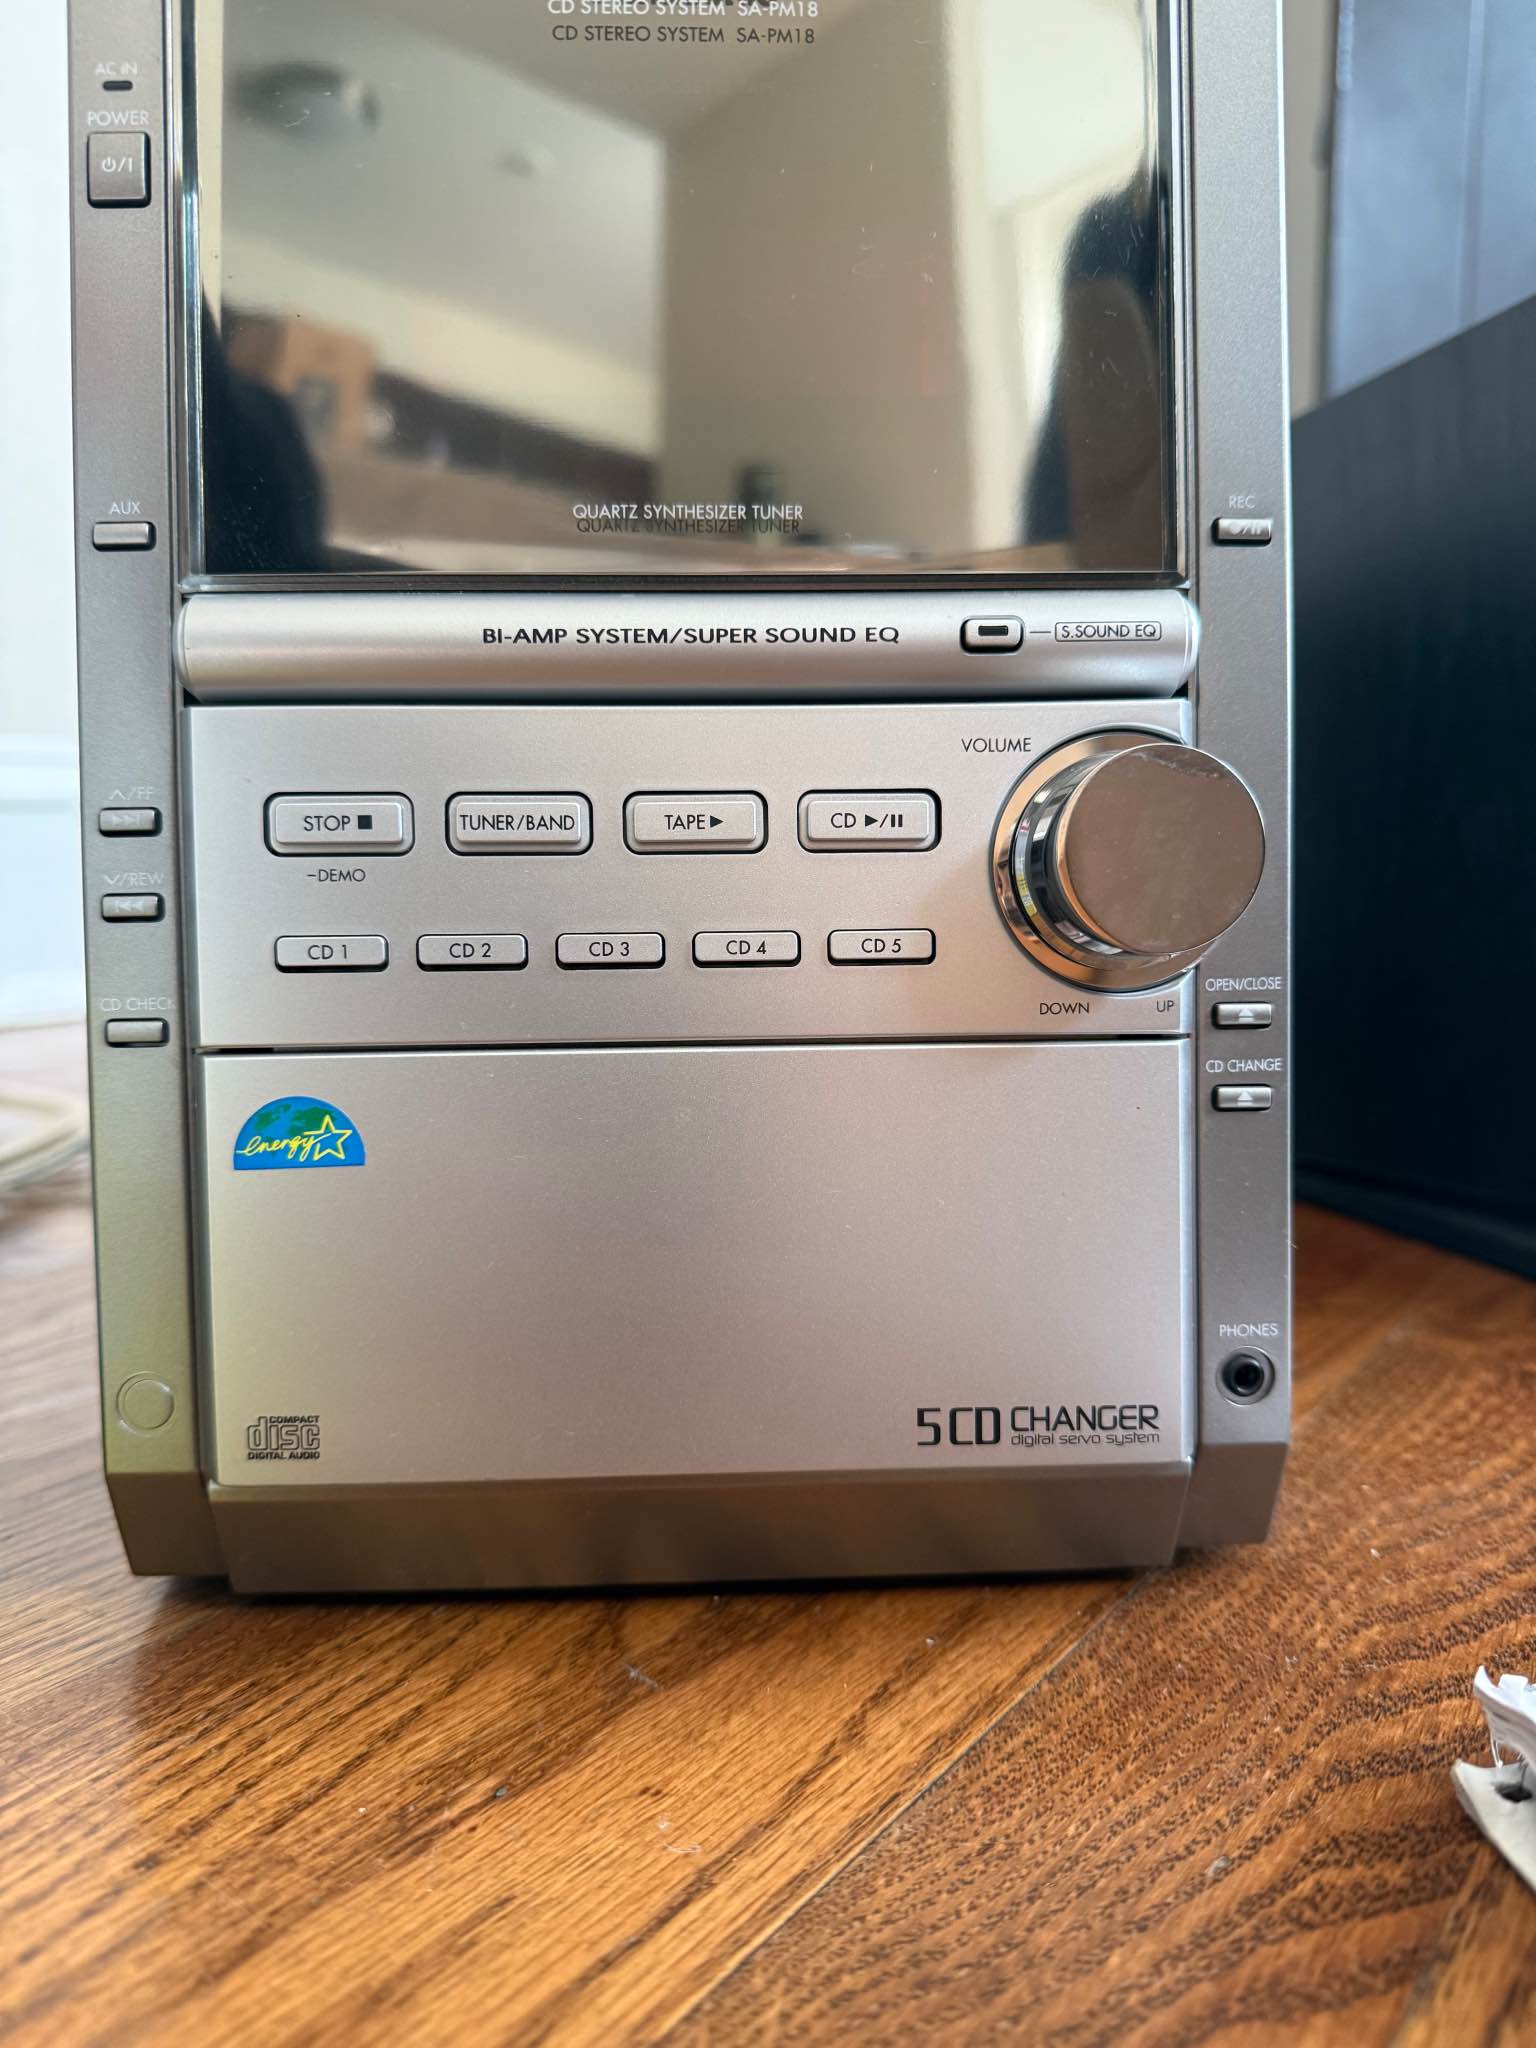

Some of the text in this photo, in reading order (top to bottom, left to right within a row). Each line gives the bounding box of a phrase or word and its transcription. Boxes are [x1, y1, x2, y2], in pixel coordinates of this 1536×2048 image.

[547, 0, 818, 17] CD STEREO SYSTEM SA-PM18
[552, 25, 815, 44] CD STEREO SYSTEM SA-PM18
[95, 62, 138, 76] AC IN
[87, 111, 149, 126] POWER
[109, 501, 141, 515] AUX
[1228, 495, 1256, 509] REC
[572, 504, 803, 520] QUARTZ SYNTHESIZER TUNER
[482, 626, 901, 645] BI-AMP SYSTEM/SUPER SOUND EQ
[1061, 624, 1157, 639] S.SOUND EQ
[960, 737, 1032, 753] VOLUME
[303, 815, 351, 832] STOP
[459, 814, 575, 831] TUNER/BAND
[664, 814, 706, 830] TAPE
[830, 812, 857, 829] CD
[307, 944, 349, 960] CD 1
[449, 943, 492, 958] CD 2
[588, 941, 630, 957] CD 3
[726, 940, 767, 955] CD 4
[861, 938, 902, 953] CD 5
[1205, 977, 1282, 992] OPEN/CLOSE
[101, 998, 121, 1011] CD
[1039, 1001, 1091, 1016] DOWN
[1156, 1000, 1175, 1014] UP
[1205, 1058, 1282, 1073] CD CHANGE
[1219, 1323, 1279, 1337] PHONES
[269, 1415, 320, 1424] COMPACT
[1010, 1404, 1160, 1432] CHANGER
[1011, 1432, 1160, 1448] digital servo system
[247, 1451, 320, 1460] DIGITAL AUDIO
